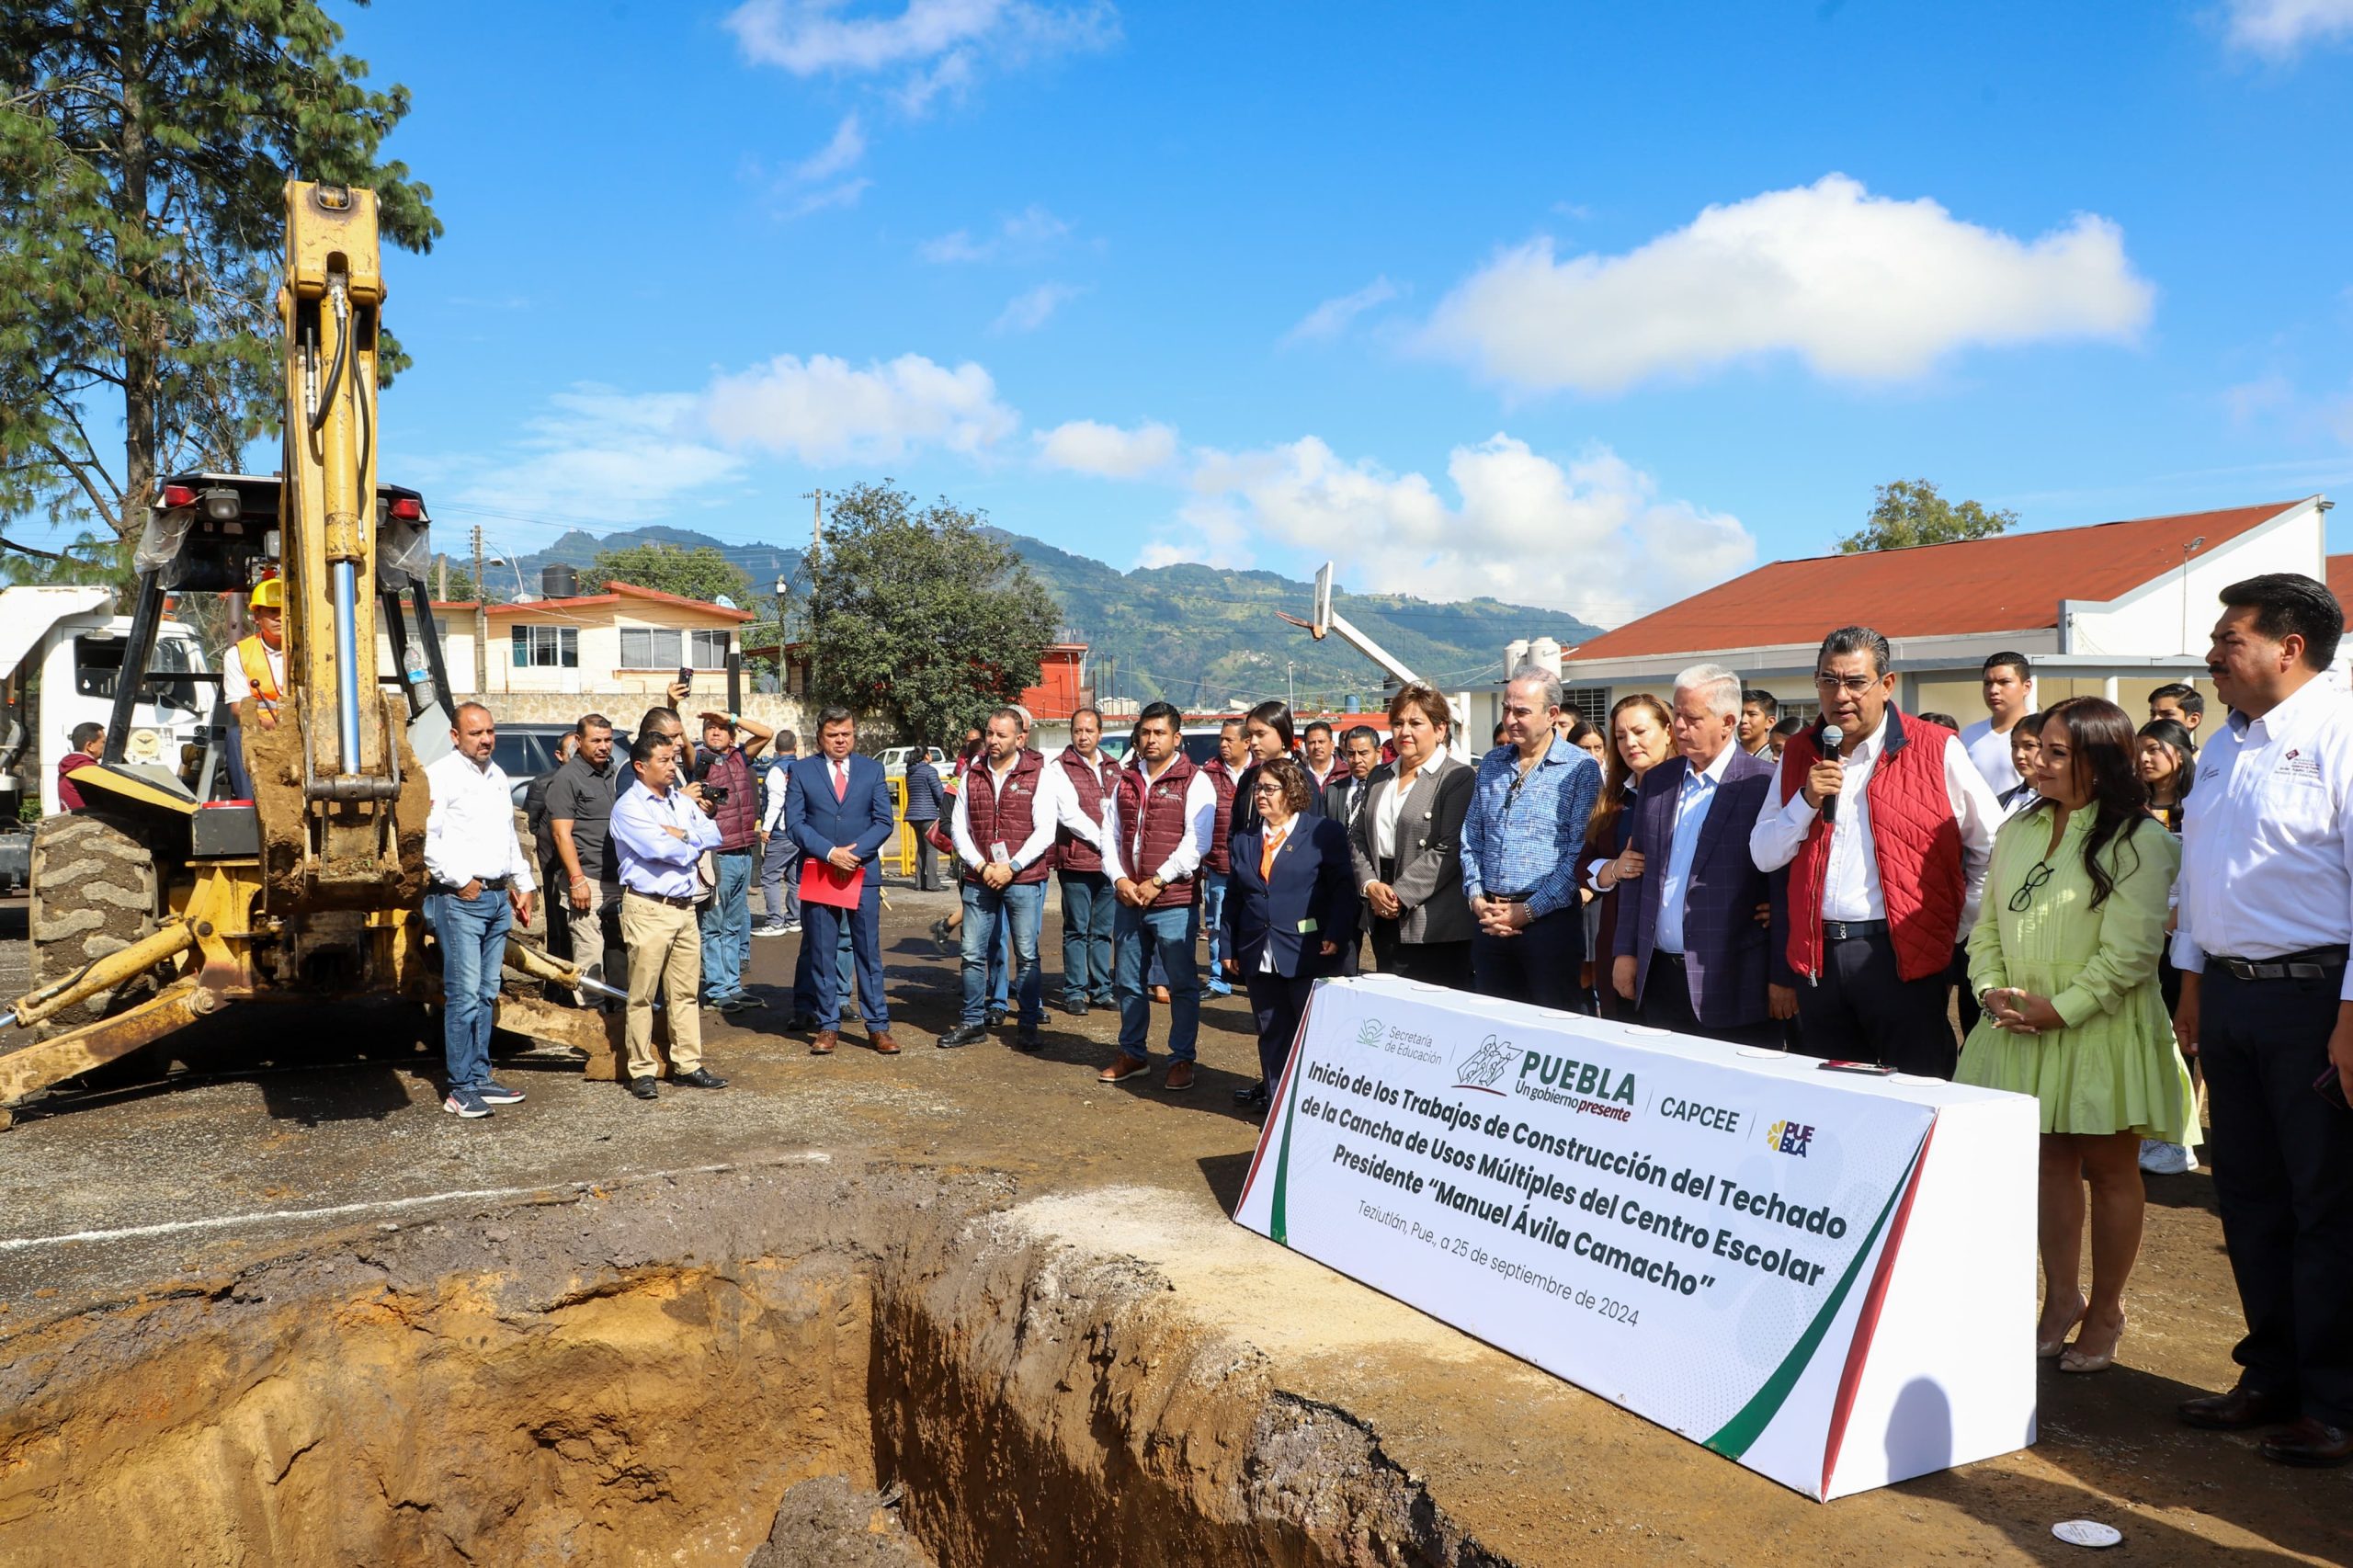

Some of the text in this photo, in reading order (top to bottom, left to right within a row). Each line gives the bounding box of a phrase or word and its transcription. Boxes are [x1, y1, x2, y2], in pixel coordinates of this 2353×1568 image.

[1384, 1040, 1442, 1065] de Educación
[1388, 1025, 1433, 1049] Secretaría
[1519, 1051, 1635, 1106] PUEBLA
[1307, 1061, 1847, 1240] Inicio de los Trabajos de Construcción del Techado
[1660, 1096, 1740, 1133] CAPCEE
[1301, 1096, 1825, 1287] de la Cancha de Usos Múltiples del Centro Escolar
[1333, 1143, 1716, 1296] Presidente “Manuel Ávila Camacho”
[1358, 1199, 1407, 1235] Teziutlán,
[1440, 1237, 1450, 1250] a
[1451, 1238, 1470, 1257] 25
[1471, 1247, 1488, 1266] de
[1490, 1257, 1572, 1300] septiembre
[1574, 1290, 1596, 1310] de
[1598, 1297, 1639, 1327] 2024
